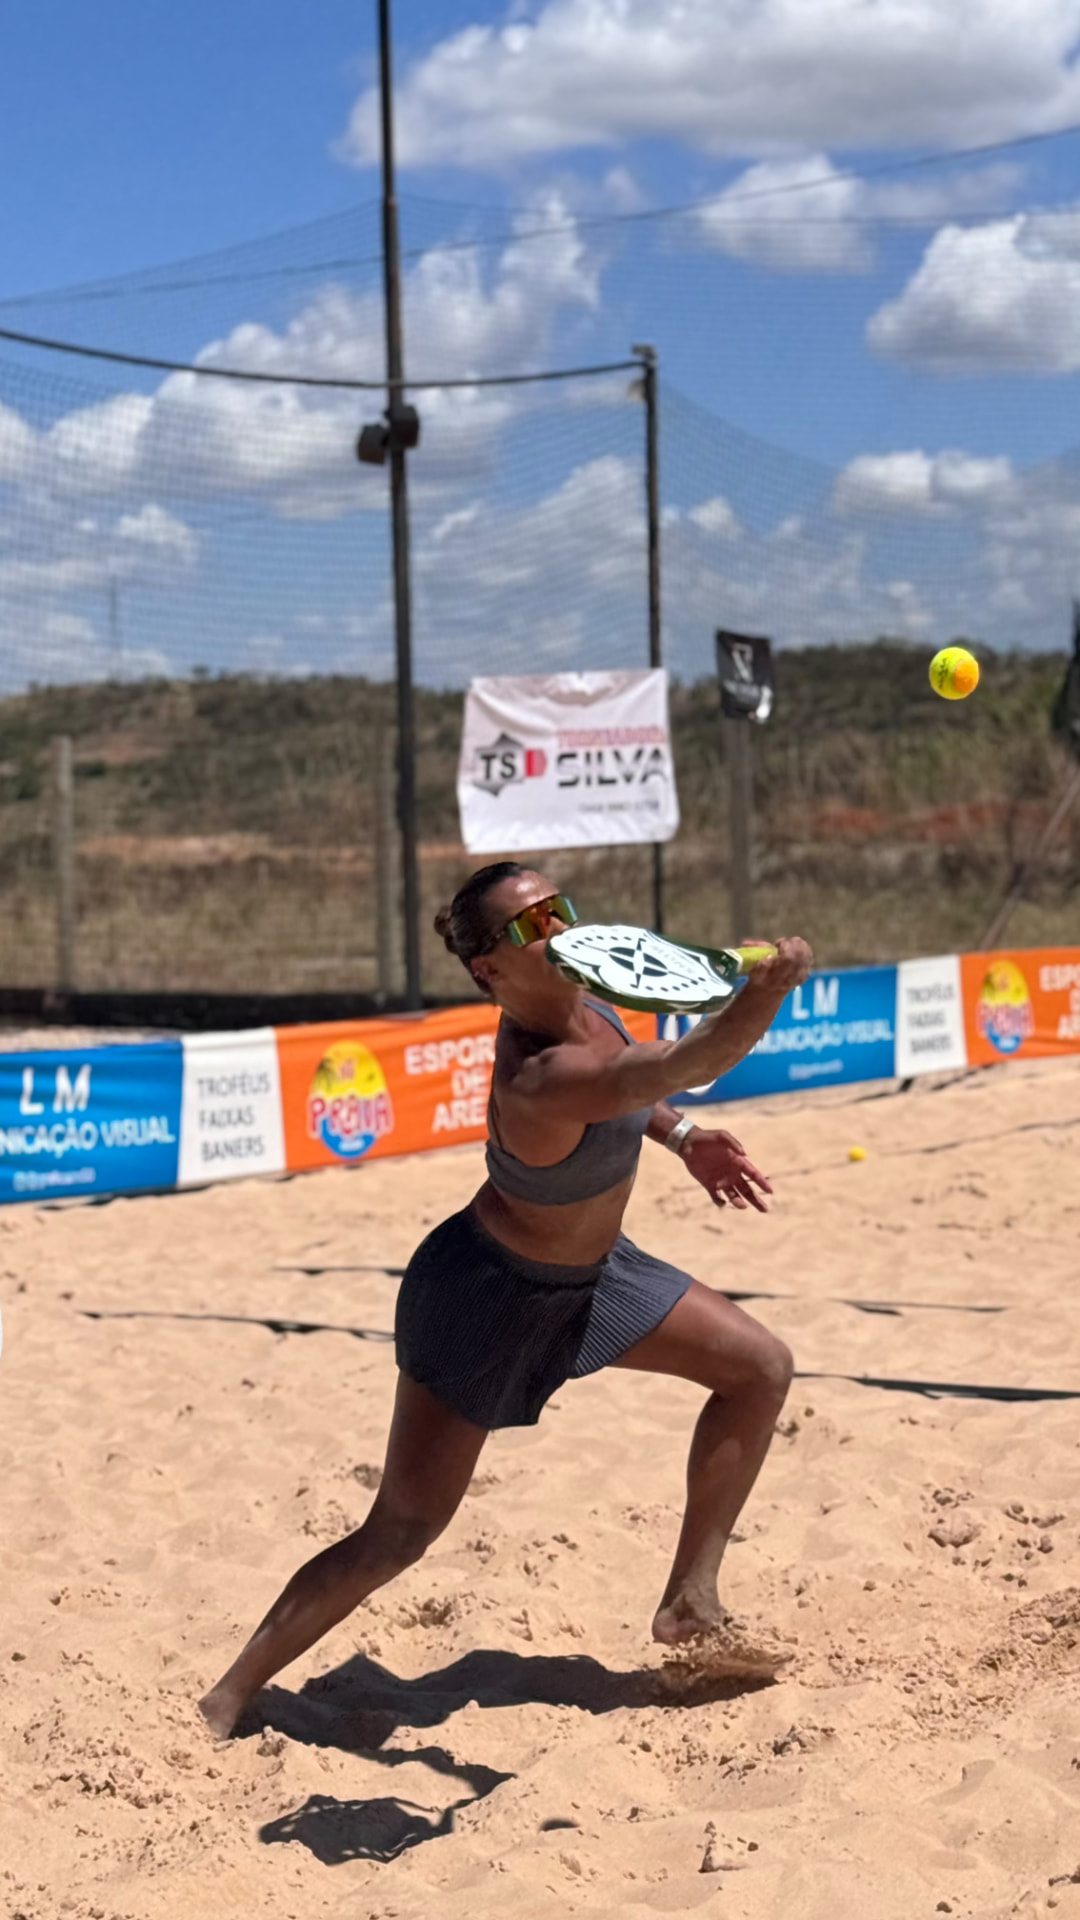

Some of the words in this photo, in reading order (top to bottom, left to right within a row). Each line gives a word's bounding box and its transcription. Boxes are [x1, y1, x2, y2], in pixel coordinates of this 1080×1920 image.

[556, 746, 668, 788] SILVA
[404, 1034, 495, 1075] ESPOR
[197, 1068, 271, 1098] TROFÉUS
[451, 1066, 489, 1098] DE
[198, 1106, 255, 1131] FAIXAS
[431, 1096, 487, 1134] ARE
[100, 1115, 176, 1148] VISUAL
[201, 1135, 265, 1163] BANERS
